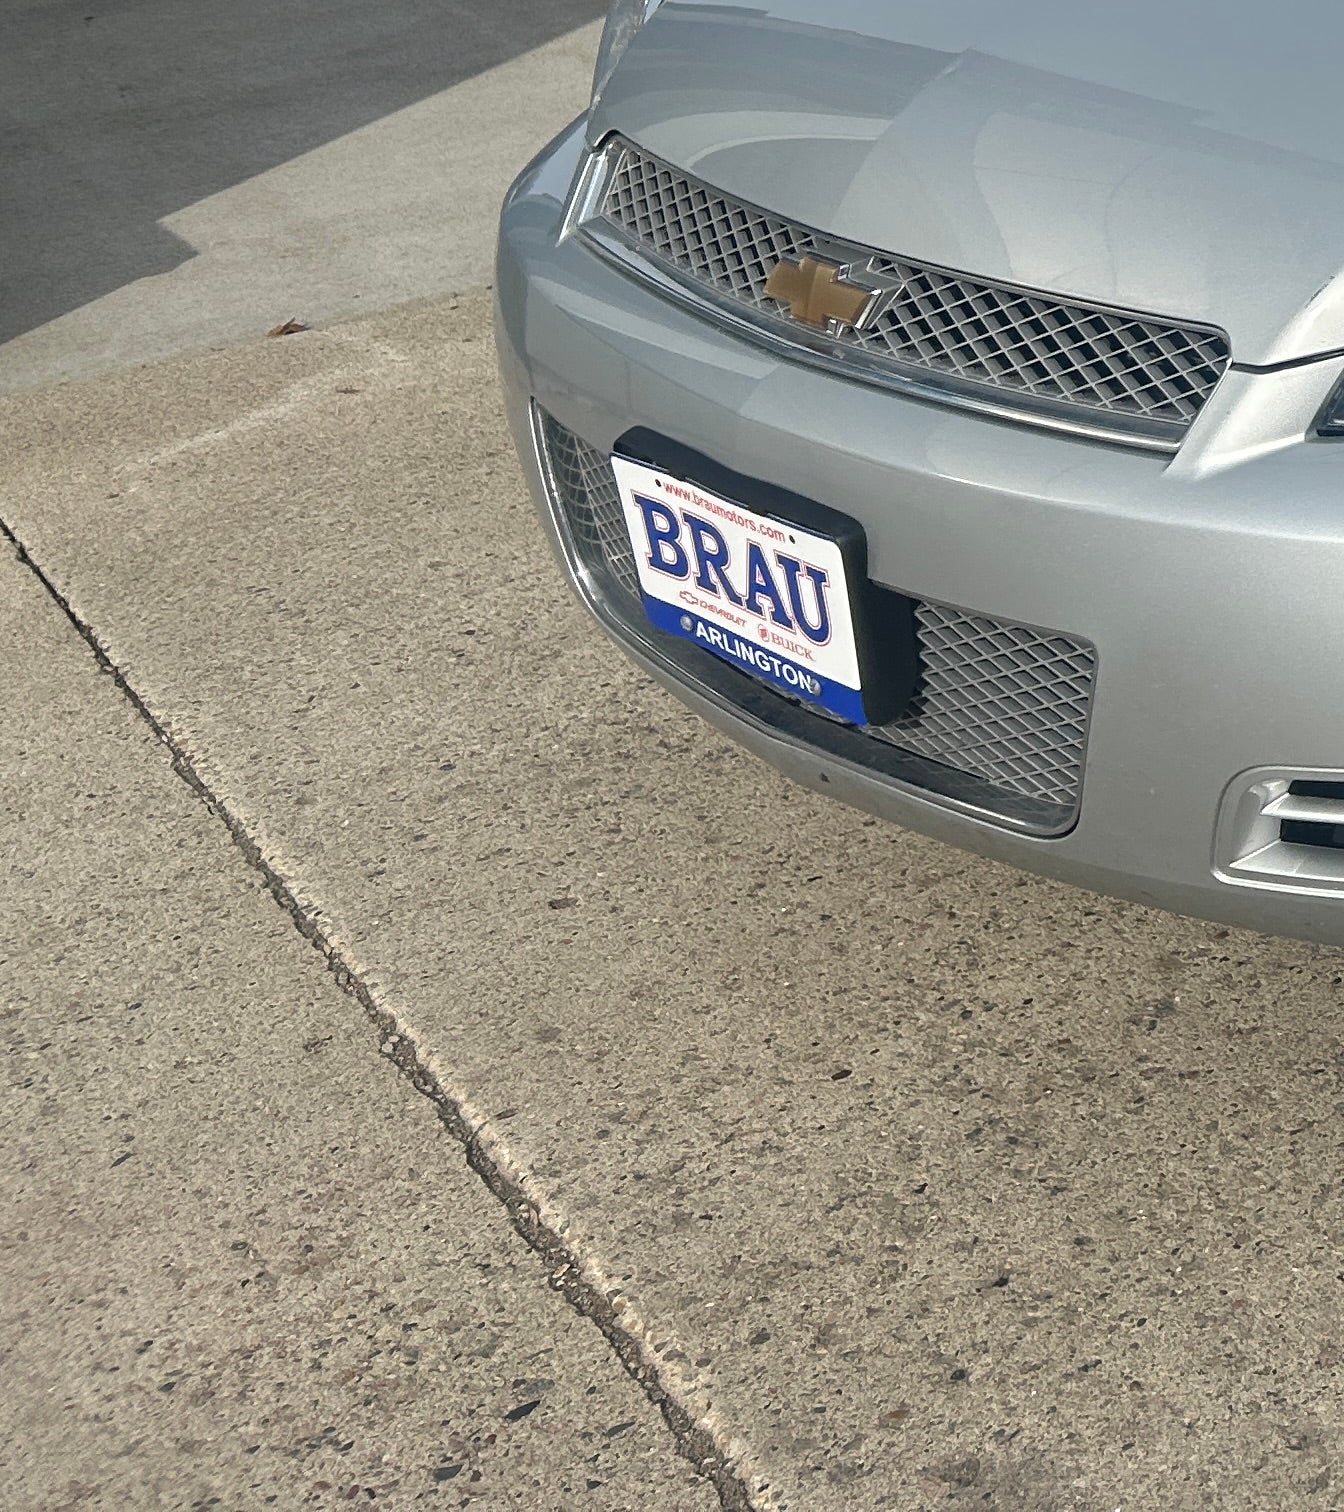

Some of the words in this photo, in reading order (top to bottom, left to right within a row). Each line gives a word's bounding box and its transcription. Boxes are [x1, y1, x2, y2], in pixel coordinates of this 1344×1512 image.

[663, 482, 785, 543] www.braumotors.com
[630, 489, 832, 647] BRAU
[700, 600, 747, 627] CHEVROLET
[696, 621, 815, 694] ARLINGTON
[770, 632, 816, 662] BUICK
